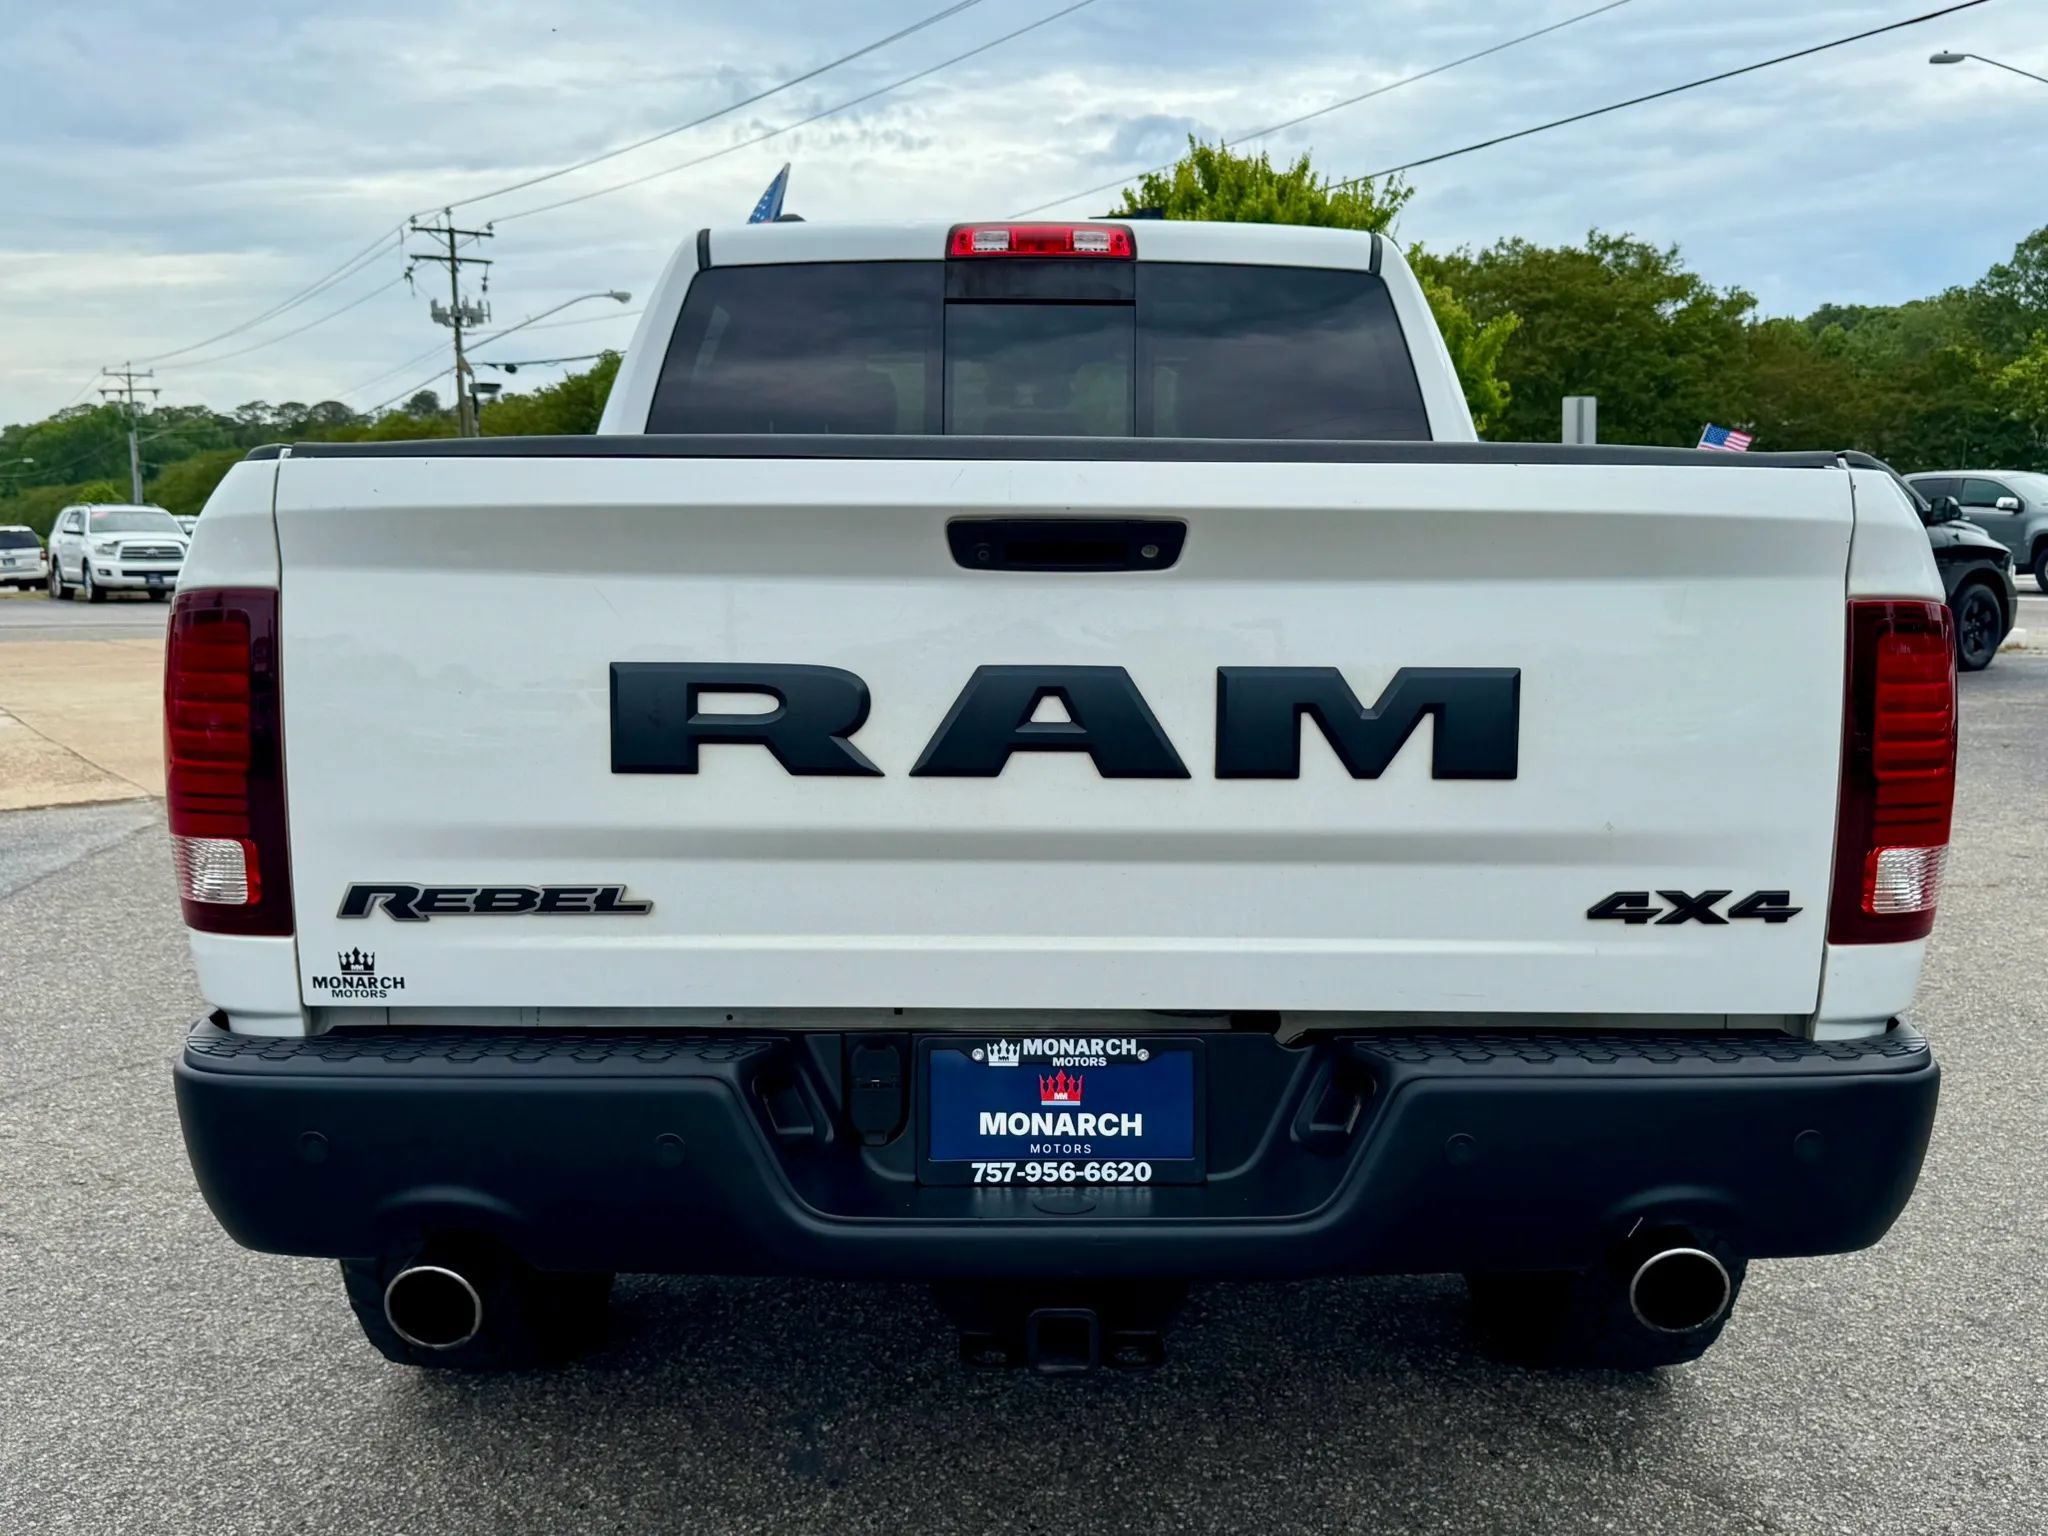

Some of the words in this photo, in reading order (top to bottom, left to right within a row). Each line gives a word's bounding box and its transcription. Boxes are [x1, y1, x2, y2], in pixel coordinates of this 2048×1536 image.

[610, 661, 1522, 779] RAM
[336, 882, 654, 922] REBEL
[1586, 890, 1803, 925] 4X4
[312, 976, 405, 989] MONARCH
[331, 989, 388, 998] MOTORS
[1023, 1039, 1137, 1055] MONARCH
[1052, 1057, 1107, 1067] MOTORS
[1054, 1092, 1068, 1100] MM
[979, 1112, 1143, 1136] MONARCH
[1030, 1144, 1092, 1154] MOTORS
[971, 1161, 1152, 1183] 757-956-6620
